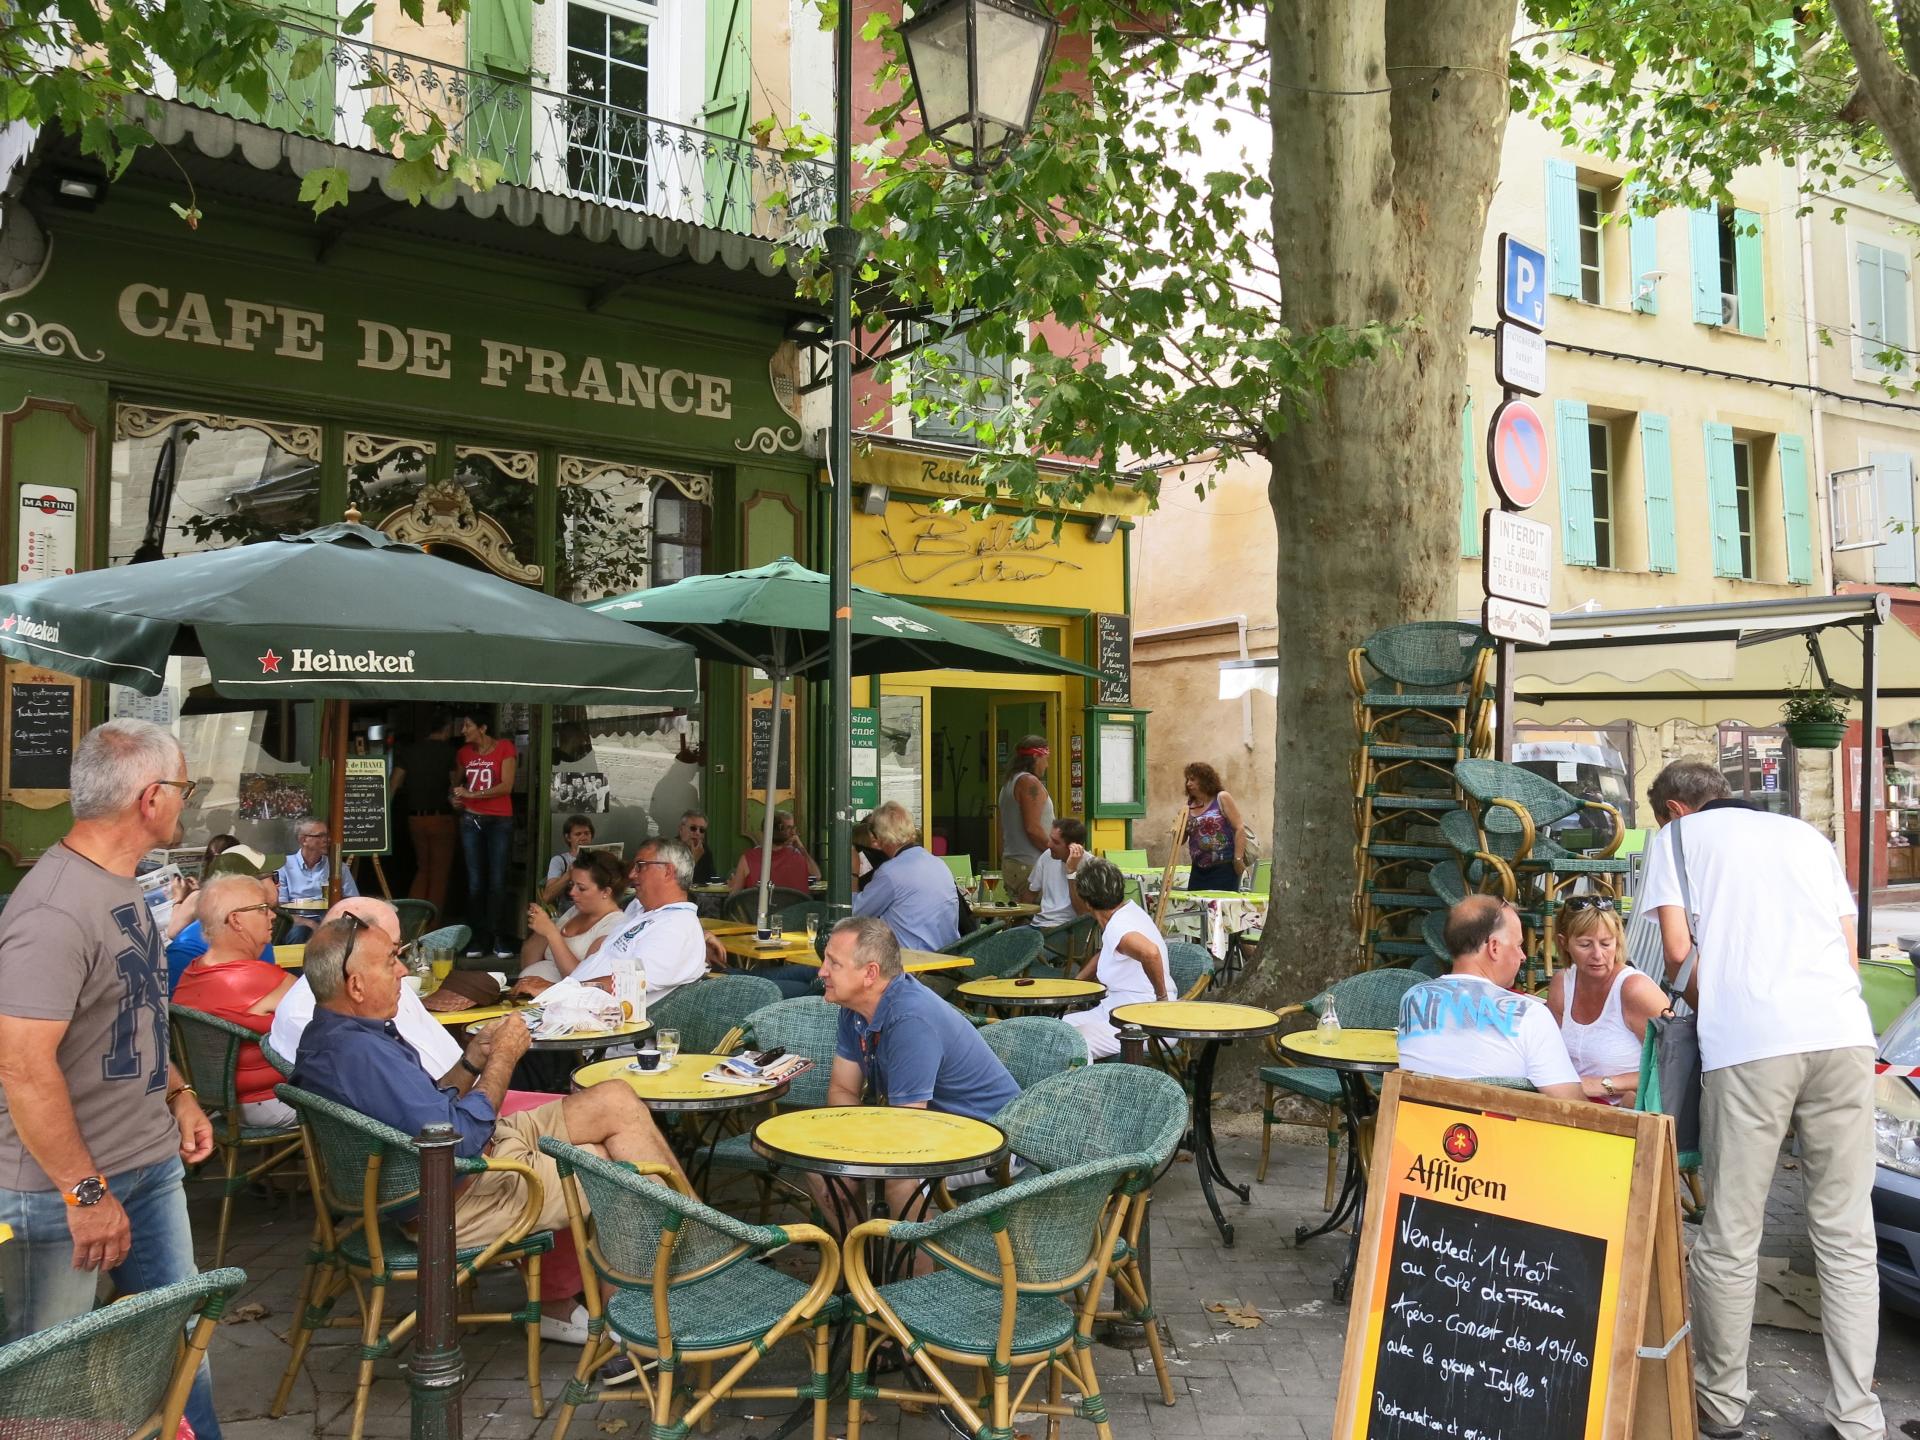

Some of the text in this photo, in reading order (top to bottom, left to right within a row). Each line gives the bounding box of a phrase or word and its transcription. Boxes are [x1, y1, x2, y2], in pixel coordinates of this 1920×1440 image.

[1517, 255, 1536, 305] P
[118, 283, 732, 420] CAFE DE FRANCE
[23, 498, 73, 511] MARTINI
[1499, 519, 1545, 548] INTERDIT
[1507, 543, 1537, 562] LE JEUDI
[1493, 556, 1550, 582] ET LE DIMANCHE
[1497, 573, 1507, 586] DE
[291, 648, 415, 673] Heineken
[360, 761, 384, 769] FRANCE
[466, 768, 492, 793] 79
[1405, 1154, 1506, 1202] Affligem
[1402, 1196, 1477, 1264] Vendredi
[1478, 1245, 1510, 1278] 14
[1401, 1262, 1427, 1277] au
[1481, 1280, 1505, 1303] de
[1505, 1287, 1566, 1318] France
[1387, 1334, 1415, 1358] avec
[1422, 1343, 1435, 1365] le
[1440, 1358, 1475, 1382] groupe
[1376, 1391, 1459, 1436] Restauration et
